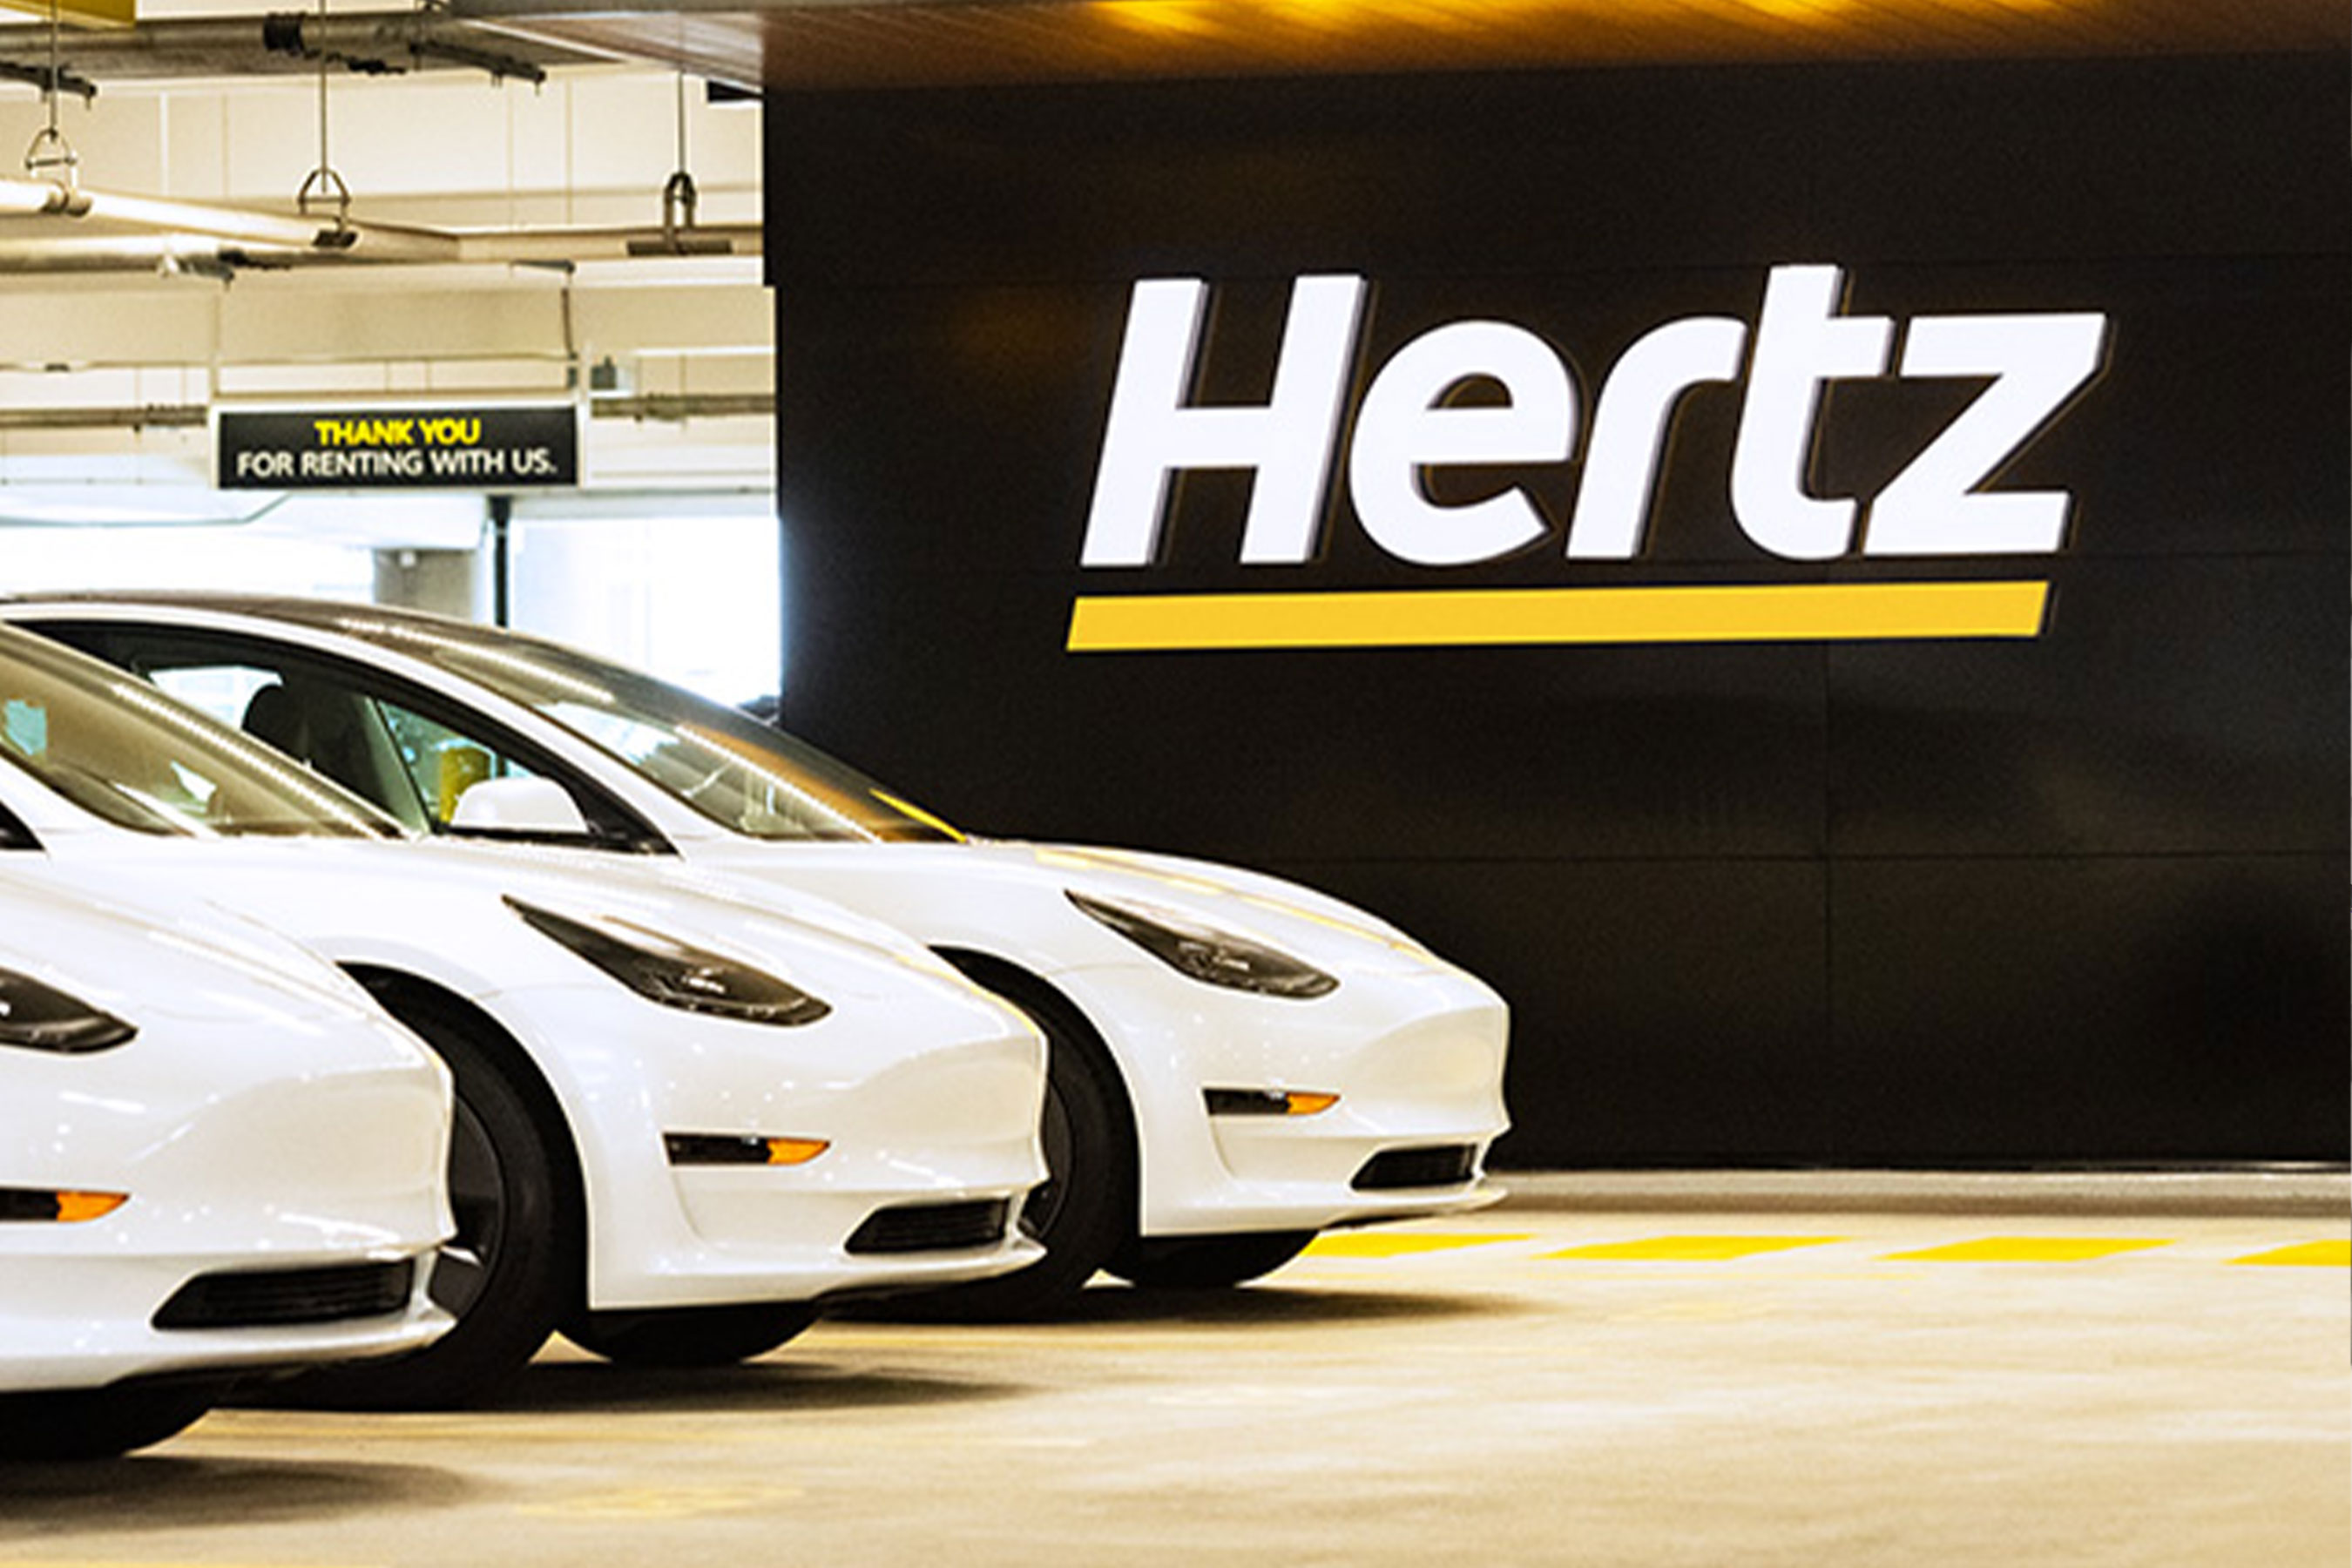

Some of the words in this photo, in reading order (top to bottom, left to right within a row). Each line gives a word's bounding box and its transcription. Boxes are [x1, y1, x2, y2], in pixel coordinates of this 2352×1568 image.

[1079, 264, 2108, 566] Hertz
[314, 419, 416, 445] THANK
[418, 418, 481, 444] YOU
[236, 451, 294, 477] FOR
[301, 449, 424, 477] RENTING
[430, 449, 504, 476] WITH
[511, 447, 558, 475] US.
